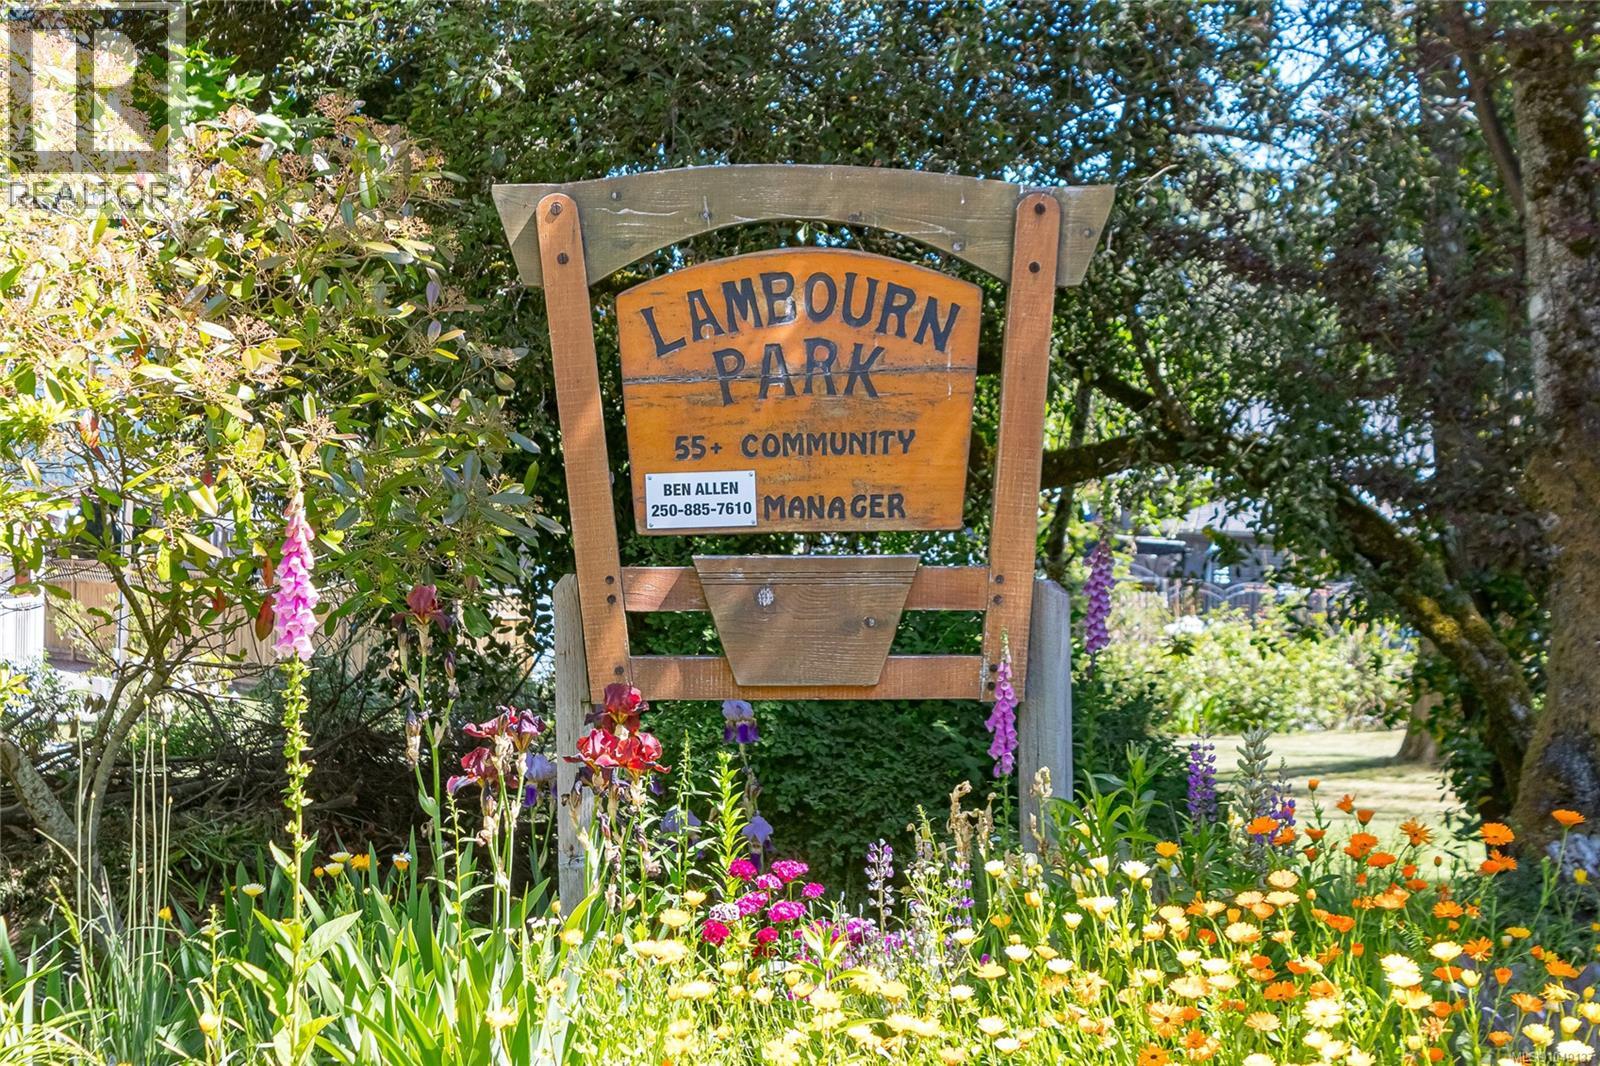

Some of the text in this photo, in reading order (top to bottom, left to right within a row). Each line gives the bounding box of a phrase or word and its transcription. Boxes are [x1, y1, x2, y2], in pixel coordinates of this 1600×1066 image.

[640, 271, 961, 357] LAMBOURN
[712, 337, 885, 407] PARK
[674, 430, 915, 461] 55+ COMMUNITY
[663, 482, 739, 496] BEN ALLEN
[651, 502, 752, 517] 250-885-7610
[763, 494, 906, 521] MANAGER
